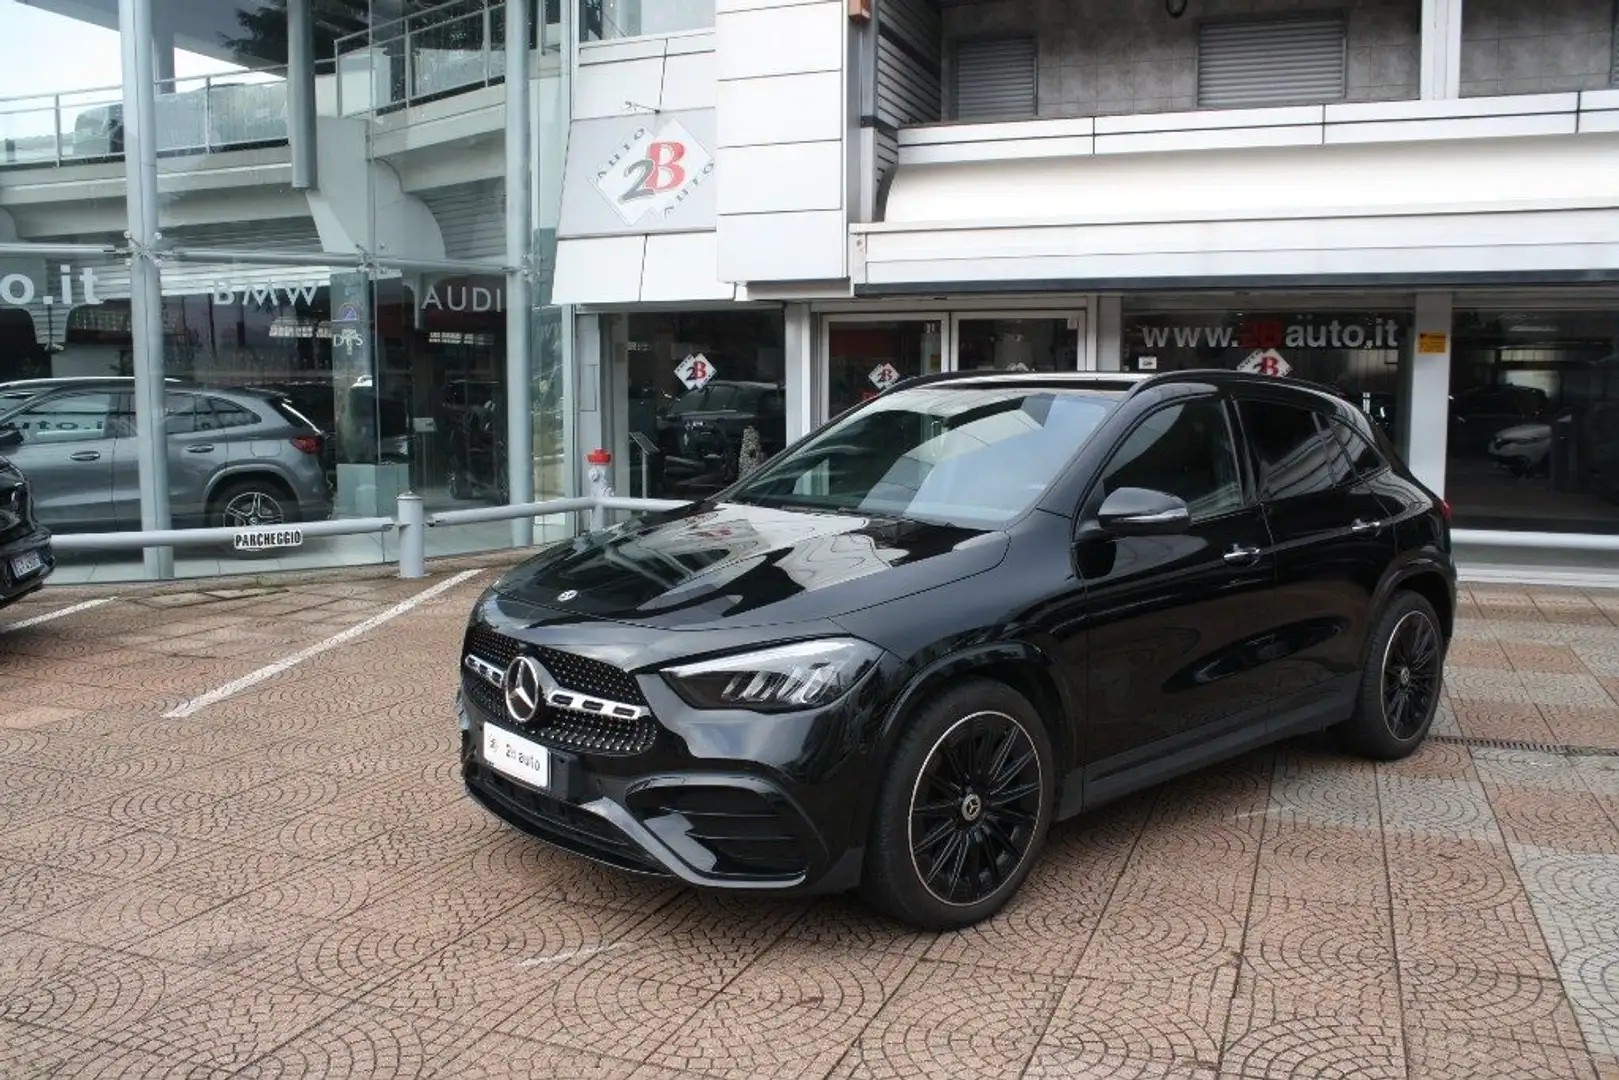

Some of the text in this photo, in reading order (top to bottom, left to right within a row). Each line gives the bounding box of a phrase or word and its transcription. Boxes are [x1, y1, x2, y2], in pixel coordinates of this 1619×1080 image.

[618, 141, 686, 203] 2B
[0, 264, 104, 304] o.it
[213, 279, 319, 306] BMW
[421, 284, 501, 312] AUDI
[685, 360, 707, 381] 2B
[235, 531, 301, 547] PARCHEGGIO
